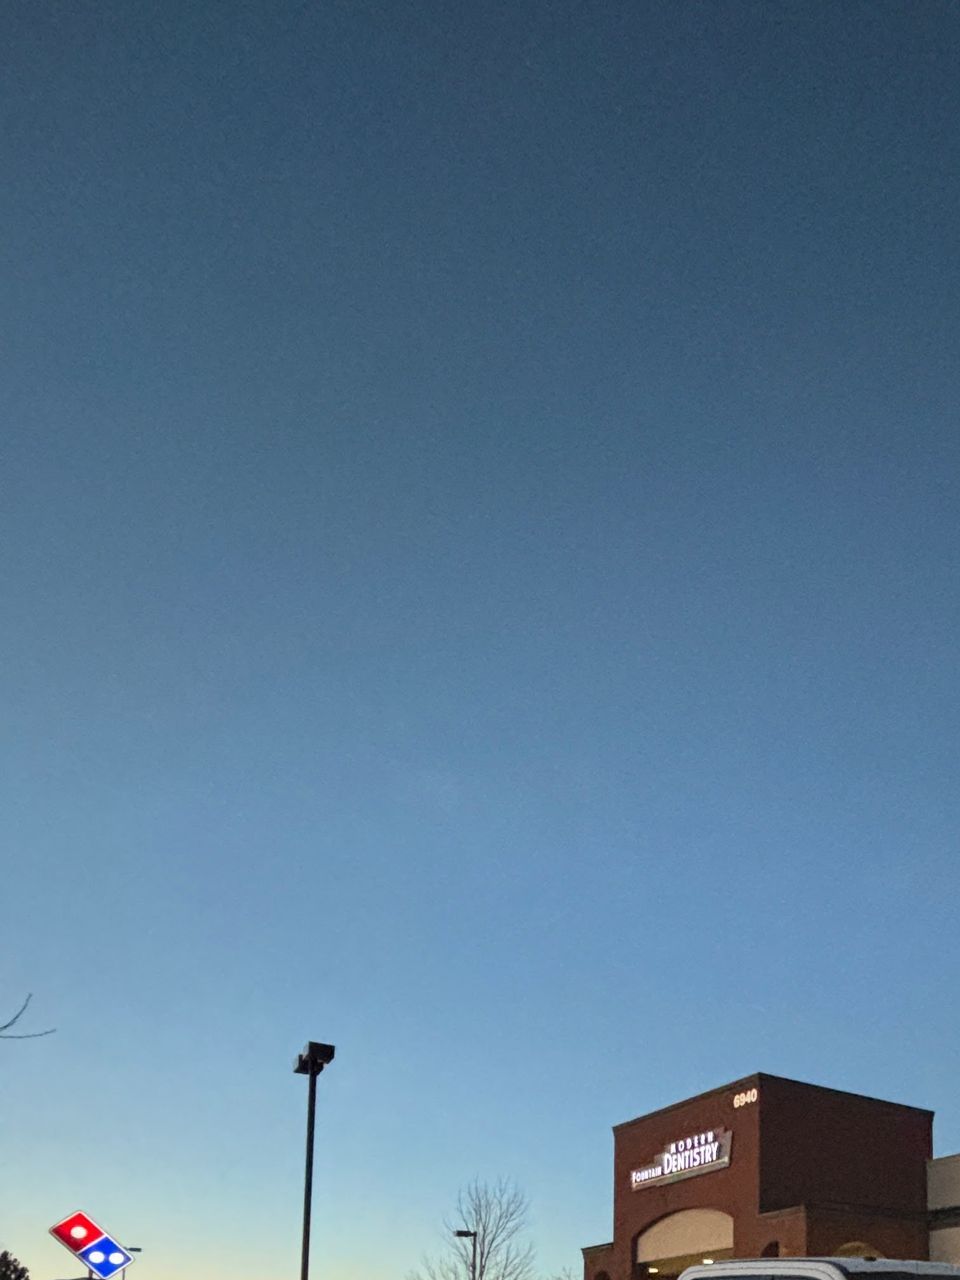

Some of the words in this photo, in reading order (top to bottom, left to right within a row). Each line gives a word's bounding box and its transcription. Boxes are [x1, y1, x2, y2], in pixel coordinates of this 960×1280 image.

[733, 1088, 758, 1109] 6940
[670, 1131, 713, 1153] MODERN
[664, 1142, 719, 1174] DENTISTRY
